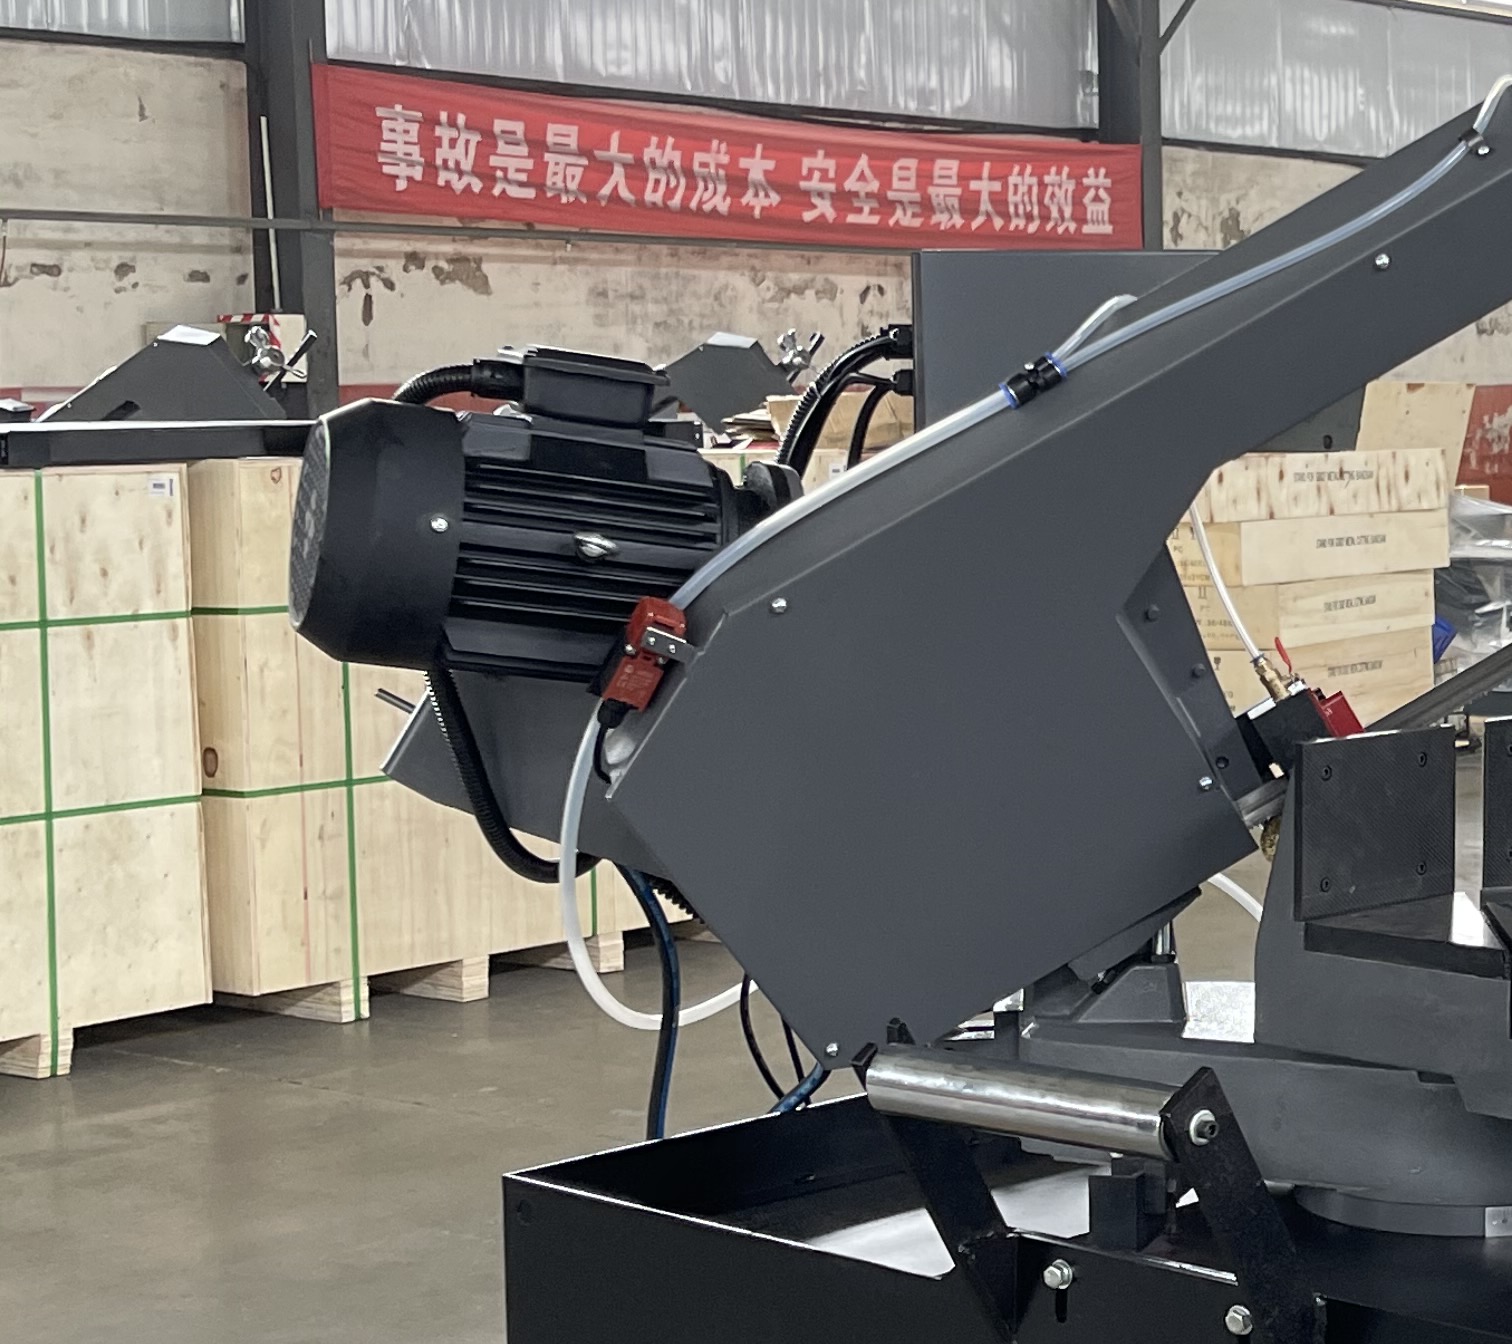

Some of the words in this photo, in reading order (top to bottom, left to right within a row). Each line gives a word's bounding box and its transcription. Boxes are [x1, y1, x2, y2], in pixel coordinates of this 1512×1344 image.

[374, 103, 781, 219] 事故是最大的成本
[798, 149, 1115, 235] 安全是最大的效益
